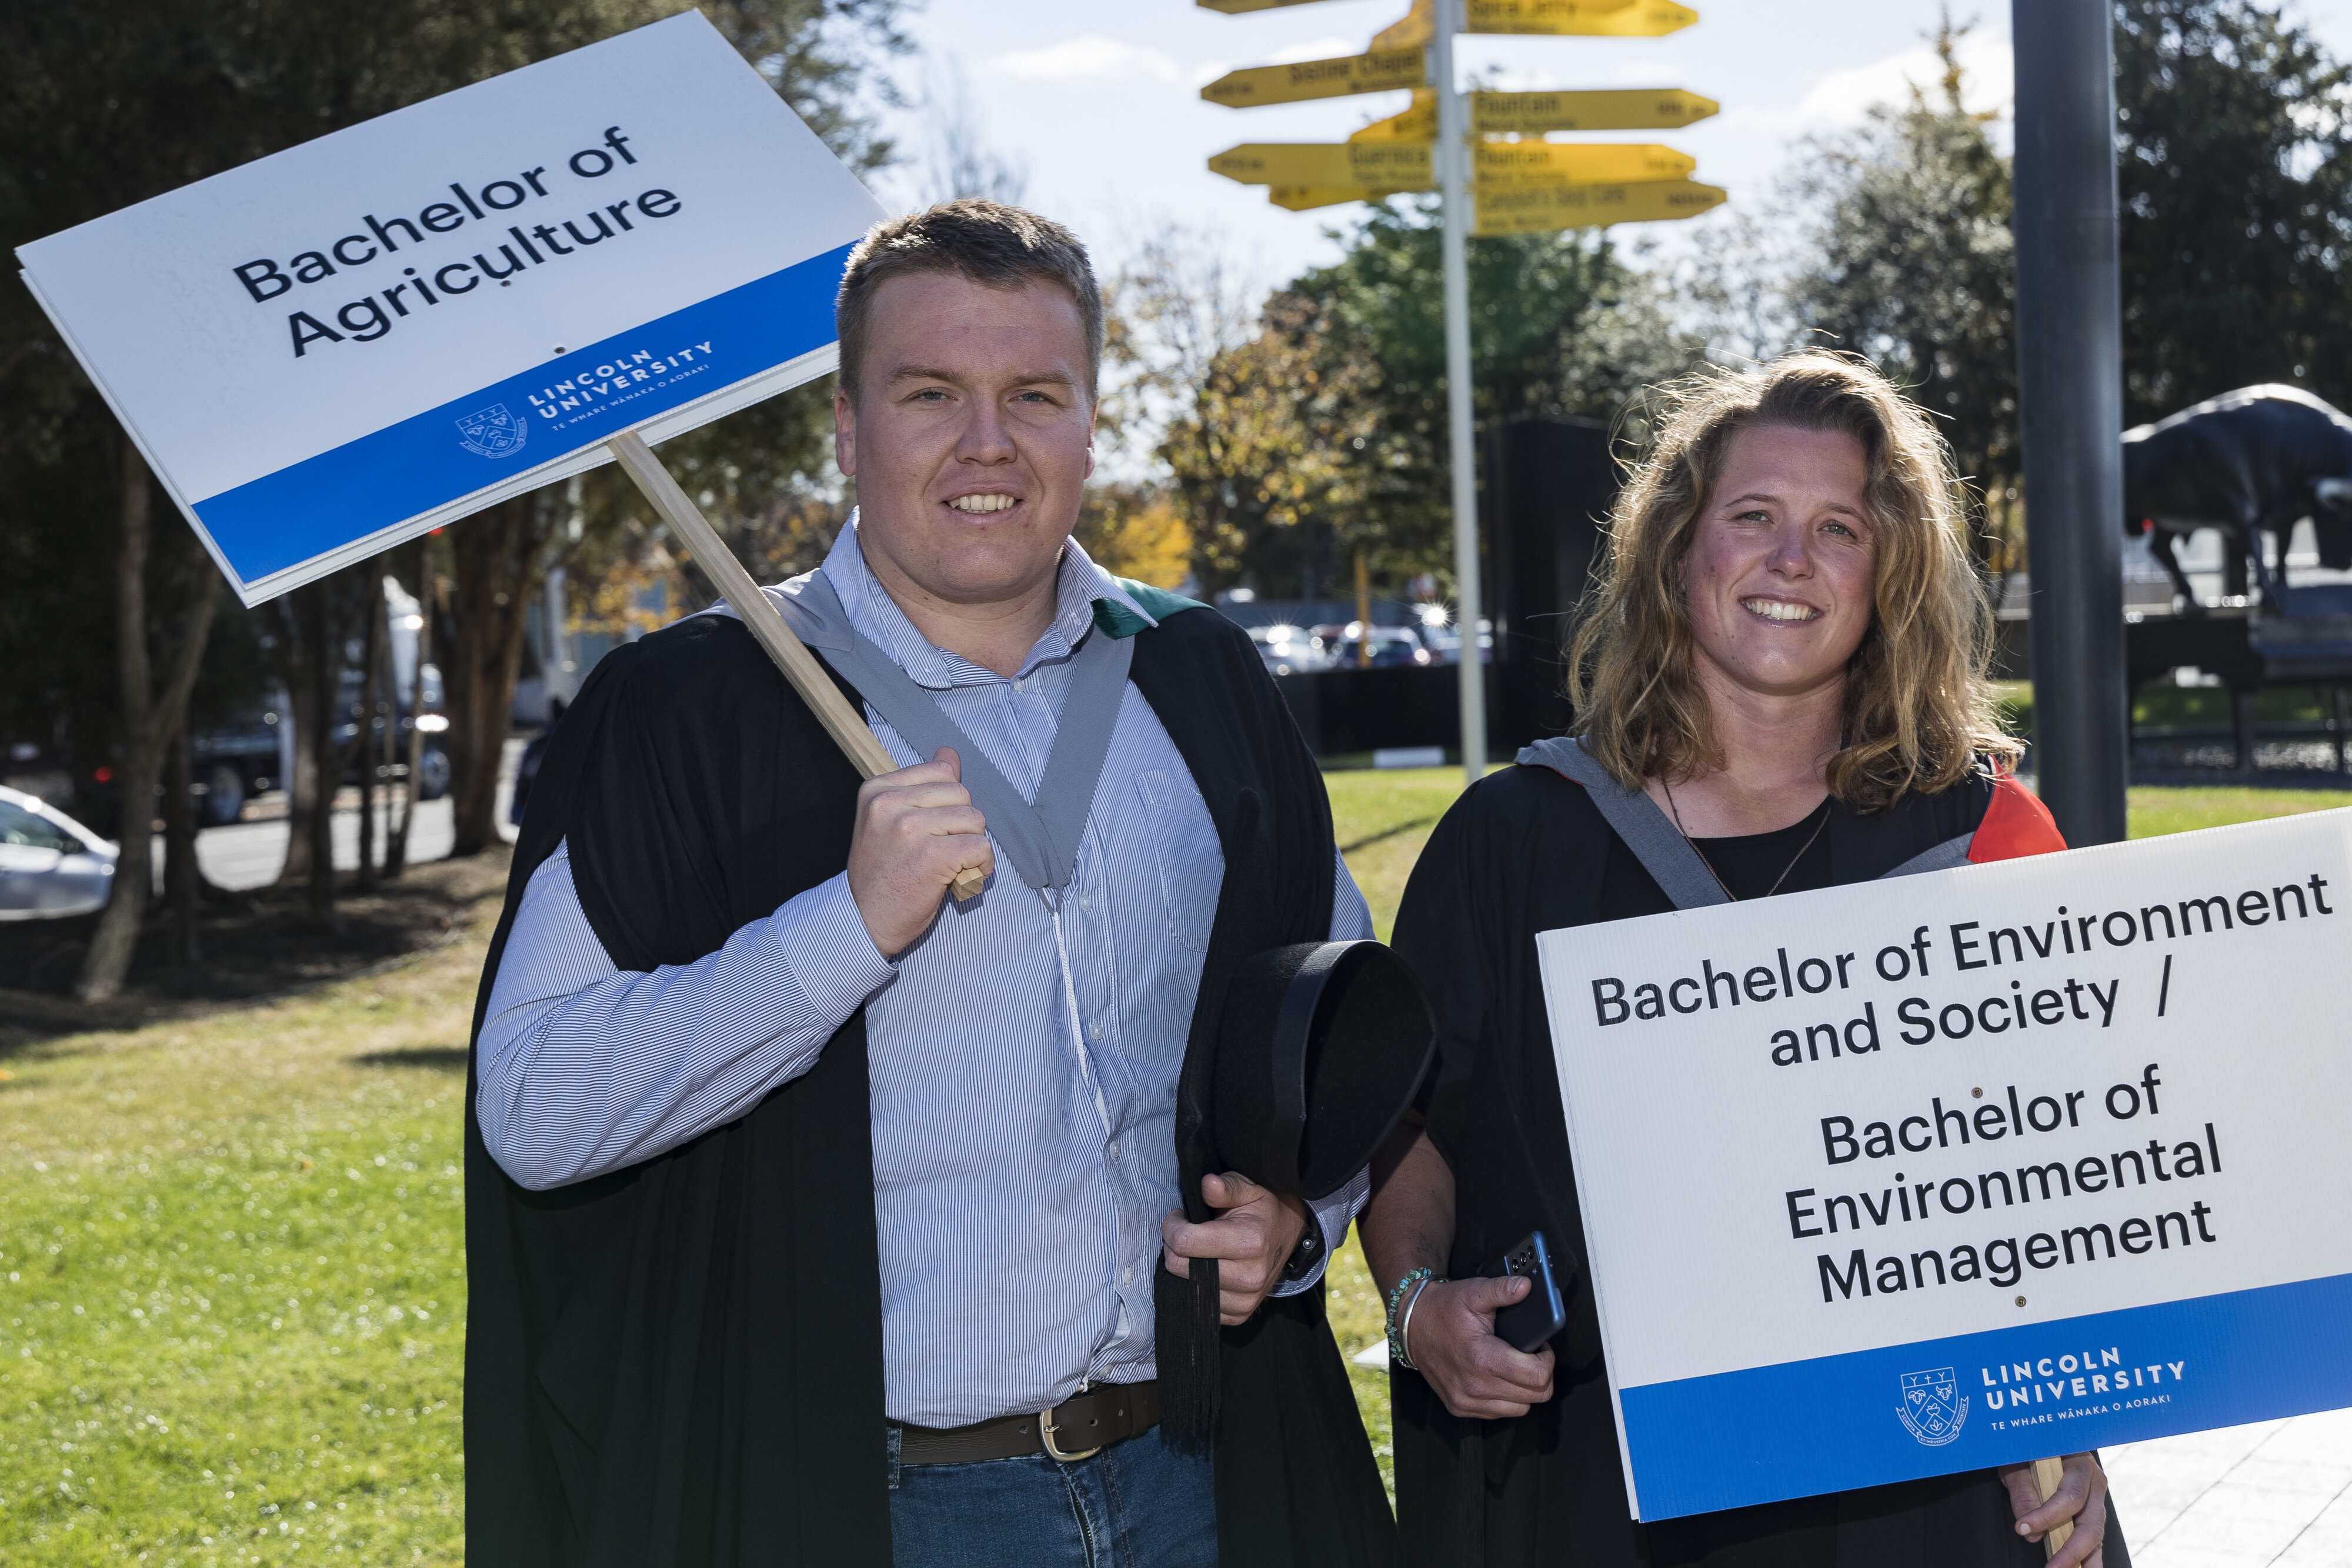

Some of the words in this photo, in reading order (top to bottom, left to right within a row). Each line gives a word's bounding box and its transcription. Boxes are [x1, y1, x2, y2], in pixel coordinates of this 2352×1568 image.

[232, 166, 548, 303] Bachelor
[569, 126, 637, 178] of
[288, 189, 681, 358] Agriculture
[528, 349, 652, 406] LINCOLN
[538, 341, 712, 419] UNIVERSITY
[552, 422, 566, 431] TE
[569, 405, 608, 423] WHARE
[669, 364, 709, 383] AORAKI
[1591, 948, 1855, 1027] Bachelor
[1876, 925, 1931, 982] of
[1950, 873, 2333, 971] Environment
[1770, 1001, 1881, 1066] and
[1897, 978, 2119, 1046] Society
[2157, 954, 2172, 1017] /
[1820, 1085, 2085, 1165] Bachelor
[2105, 1063, 2161, 1120] of
[1785, 1122, 2222, 1239] Environmental
[1817, 1200, 2217, 1303] Management
[1981, 1347, 2120, 1386] LINCOLN
[1986, 1361, 2184, 1410] UNIVERSITY
[1991, 1422, 2005, 1430] TE
[2010, 1414, 2053, 1427] WHARE
[2057, 1405, 2108, 1419] WĀNAKA
[2113, 1403, 2121, 1411] O
[2126, 1395, 2170, 1409] AORAKI
